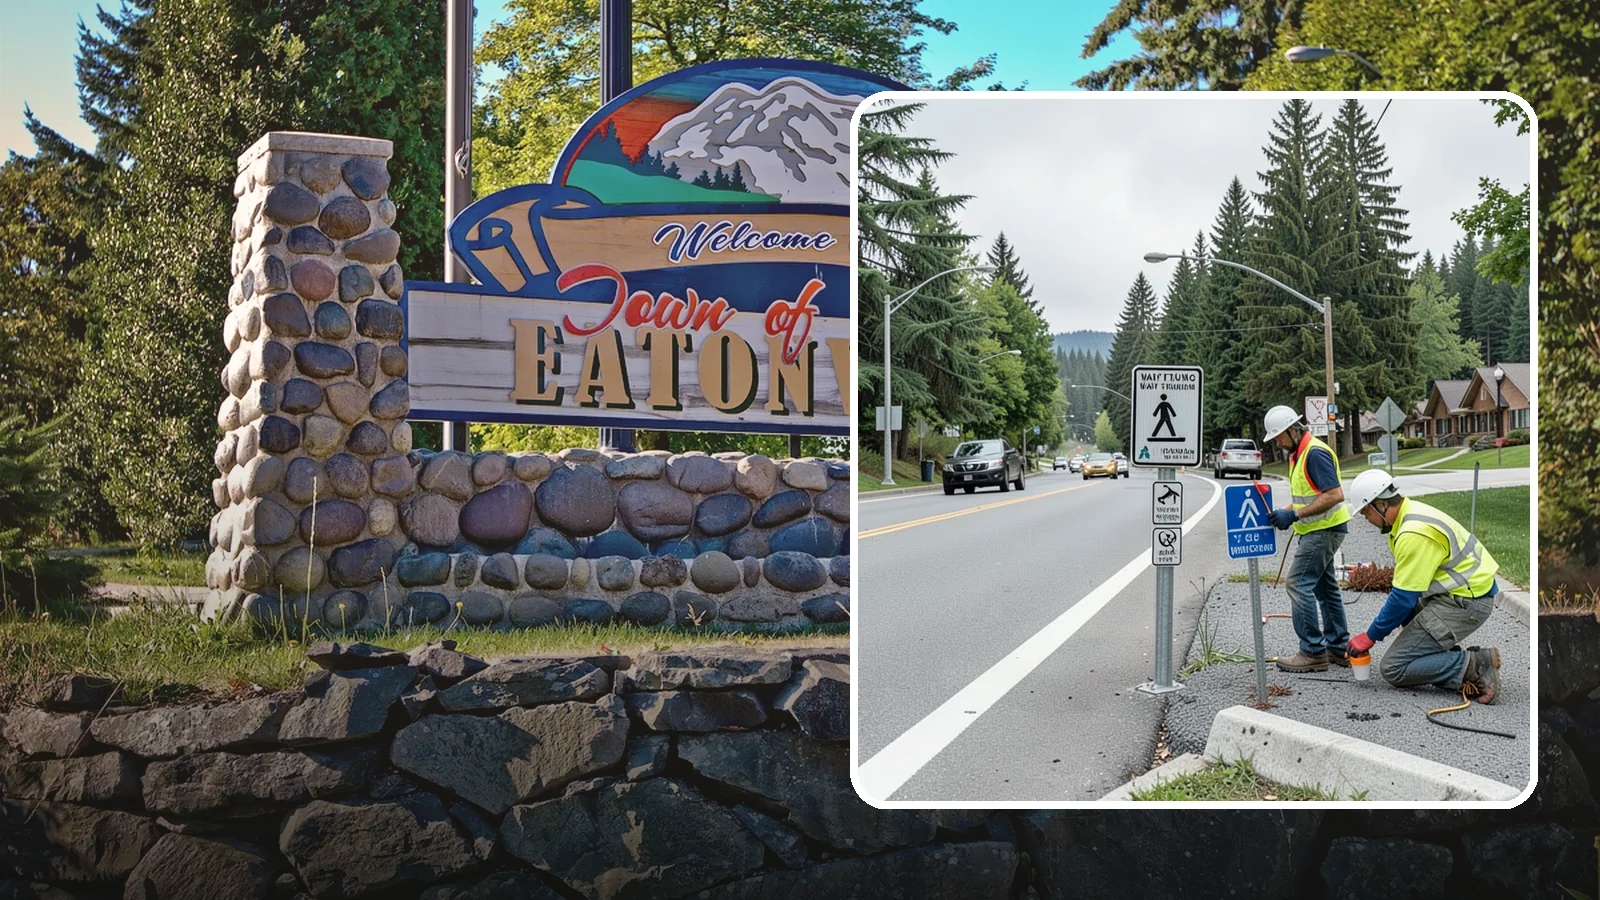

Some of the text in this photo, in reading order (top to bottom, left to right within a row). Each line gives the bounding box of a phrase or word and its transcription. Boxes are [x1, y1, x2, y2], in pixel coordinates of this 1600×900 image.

[653, 221, 837, 263] Welcome
[557, 263, 826, 366] Town of
